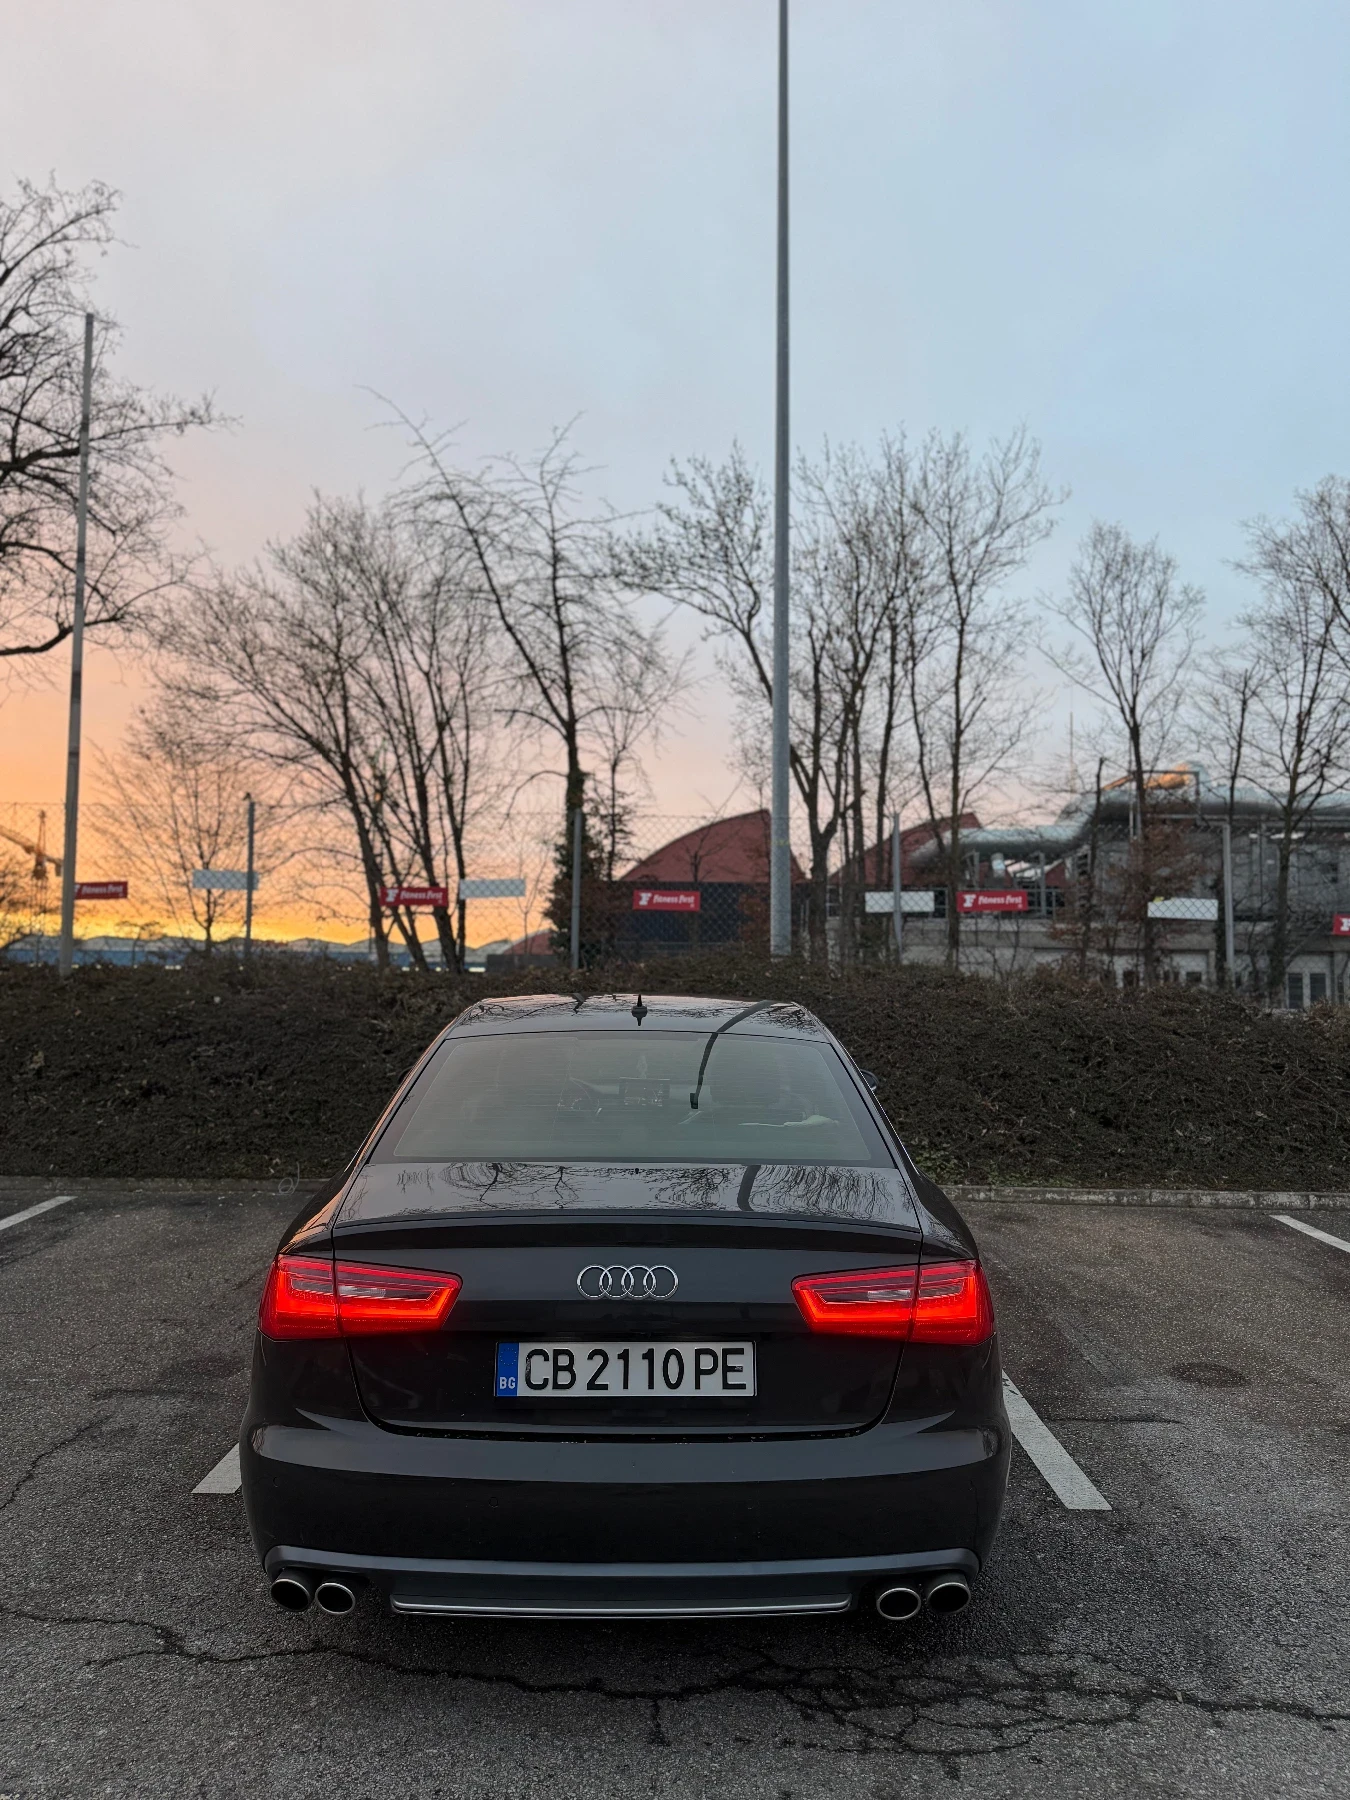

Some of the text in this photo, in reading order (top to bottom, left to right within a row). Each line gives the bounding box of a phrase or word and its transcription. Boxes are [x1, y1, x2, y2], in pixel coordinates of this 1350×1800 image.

[653, 894, 678, 904] fitness
[678, 894, 695, 904] first
[978, 895, 1005, 905] fitness
[1005, 895, 1023, 905] first
[499, 1376, 516, 1390] BG
[586, 1347, 685, 1390] 2110
[694, 1347, 747, 1390] PE
